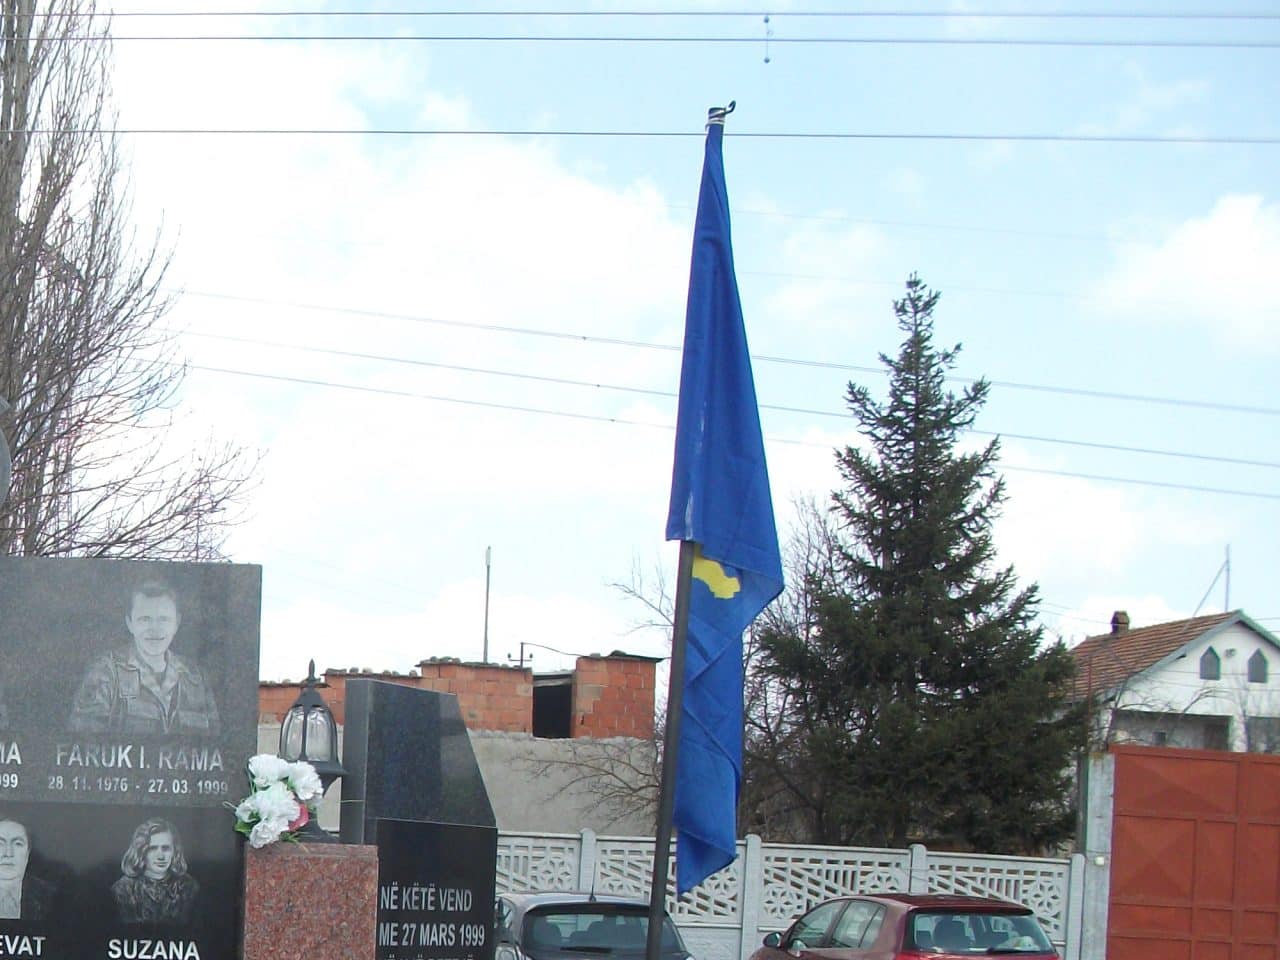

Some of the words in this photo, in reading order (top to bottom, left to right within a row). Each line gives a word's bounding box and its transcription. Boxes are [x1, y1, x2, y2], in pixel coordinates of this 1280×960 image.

[57, 745, 132, 768] FARUK
[140, 746, 149, 768] I.
[159, 749, 223, 771] RAMA
[381, 882, 398, 909] NË
[402, 883, 435, 910] KËTË
[440, 888, 472, 911] VEND
[379, 923, 398, 946] ME
[402, 923, 416, 945] 27
[420, 924, 455, 946] MARS
[460, 924, 484, 946] 1999
[108, 939, 200, 960] SUZANA
